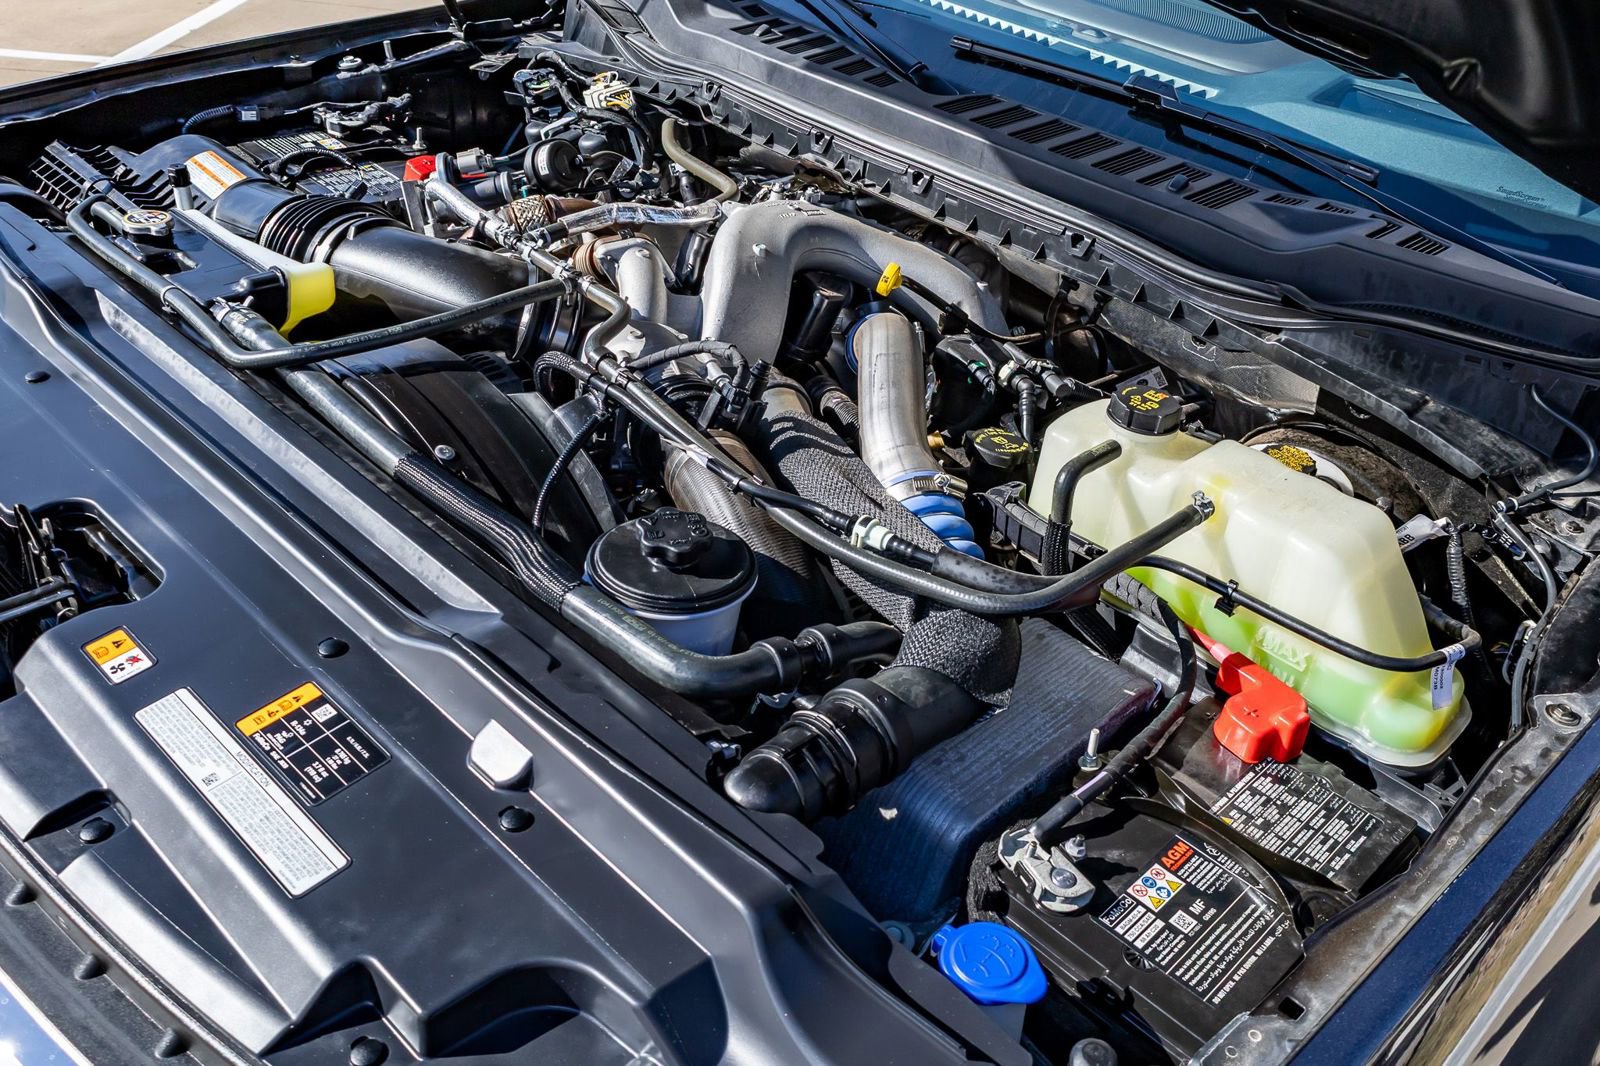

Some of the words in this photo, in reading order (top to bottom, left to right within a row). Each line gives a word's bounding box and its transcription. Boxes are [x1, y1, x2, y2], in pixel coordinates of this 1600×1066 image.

[1158, 839, 1190, 868] AGM
[1102, 895, 1133, 925] FoMoCo
[1187, 897, 1208, 915] MF
